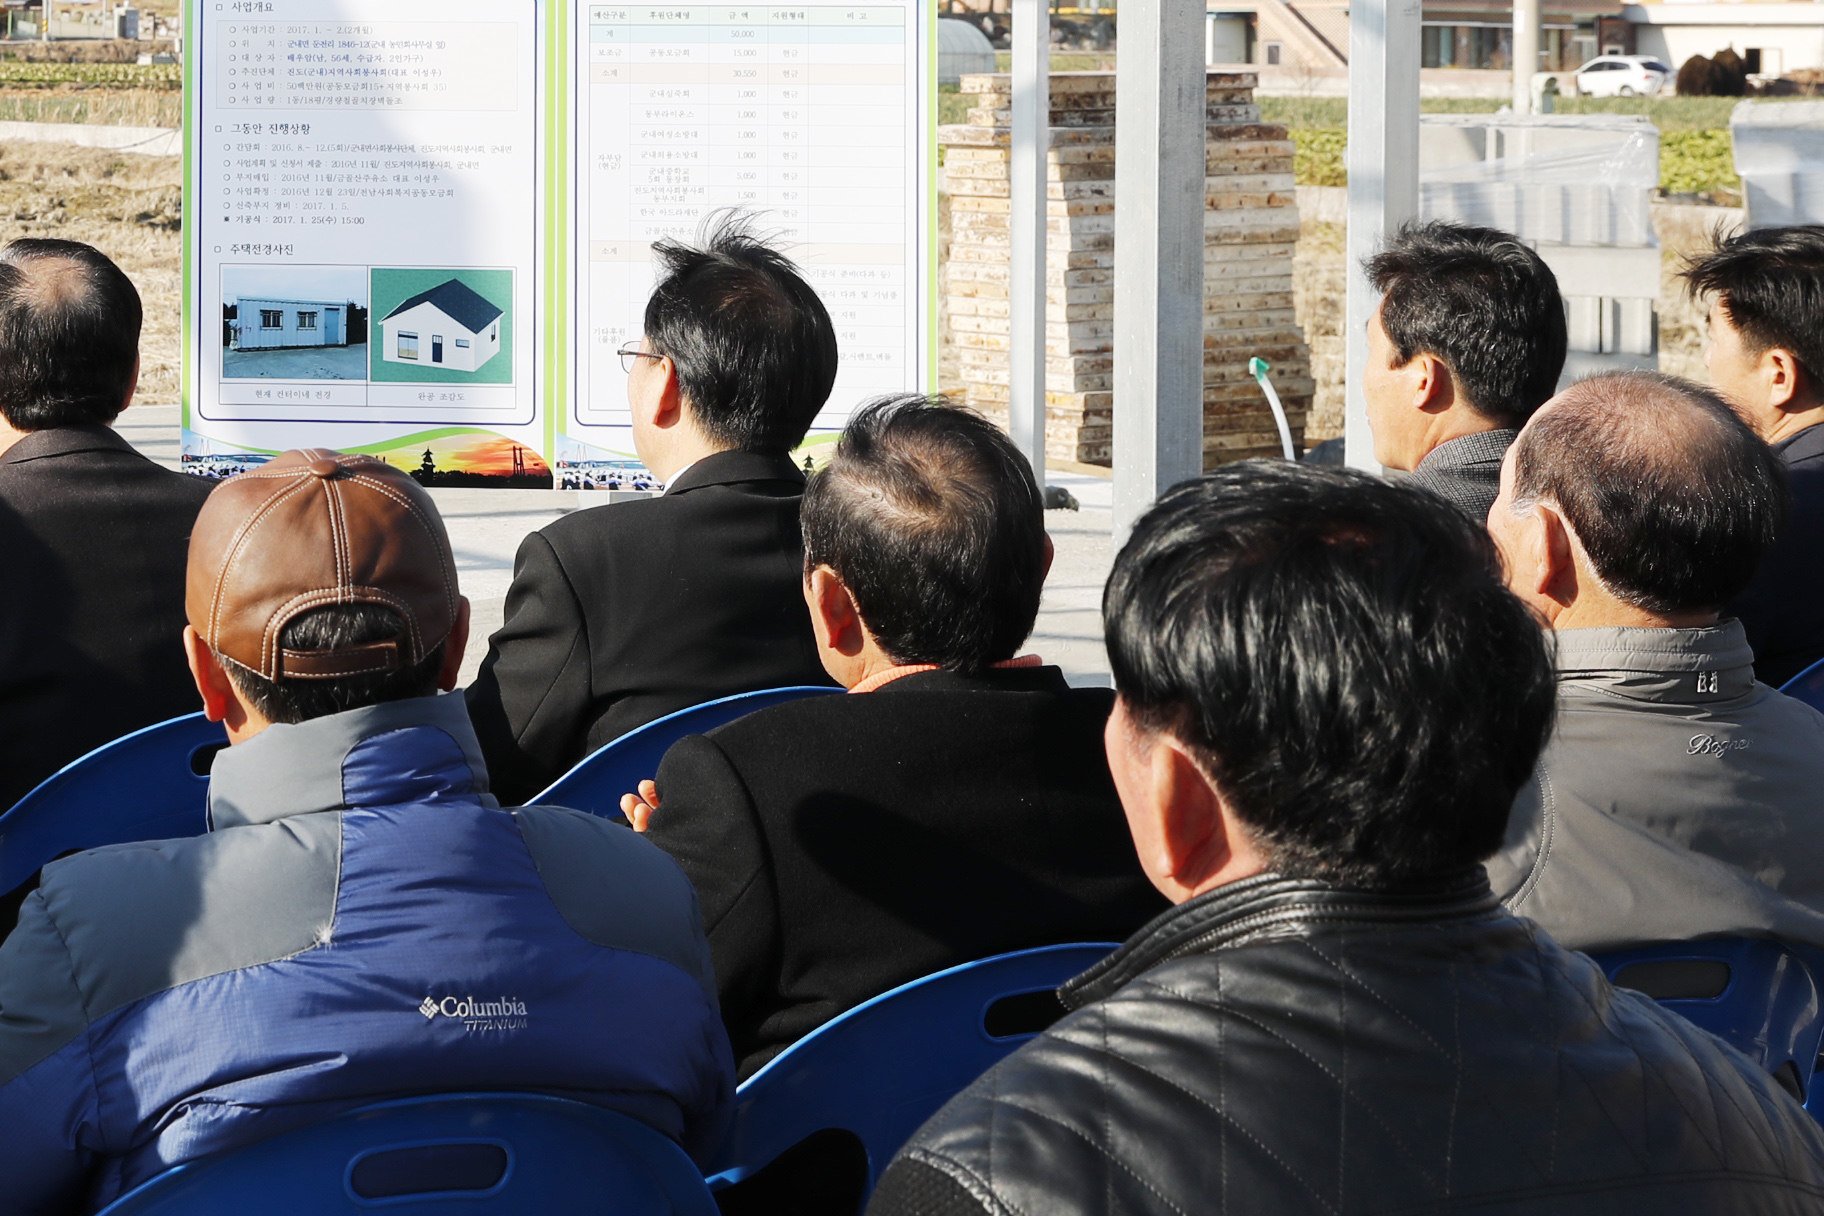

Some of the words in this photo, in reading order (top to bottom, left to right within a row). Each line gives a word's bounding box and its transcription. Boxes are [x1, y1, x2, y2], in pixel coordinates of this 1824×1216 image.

[232, 1, 274, 12] 사업개요
[242, 26, 275, 34] 사업기간
[288, 40, 309, 48] 군내면
[242, 68, 275, 76] 추진단체
[231, 123, 262, 135] 그동안
[268, 123, 311, 135] 진행상황
[236, 159, 266, 168] 사업계획
[235, 215, 261, 224] 기공식
[342, 217, 365, 225] 15:00
[230, 243, 293, 255] 주택전경사진
[1687, 734, 1754, 759] Bogner
[440, 996, 527, 1017] Columbia
[464, 1018, 527, 1031] TITANIUM
